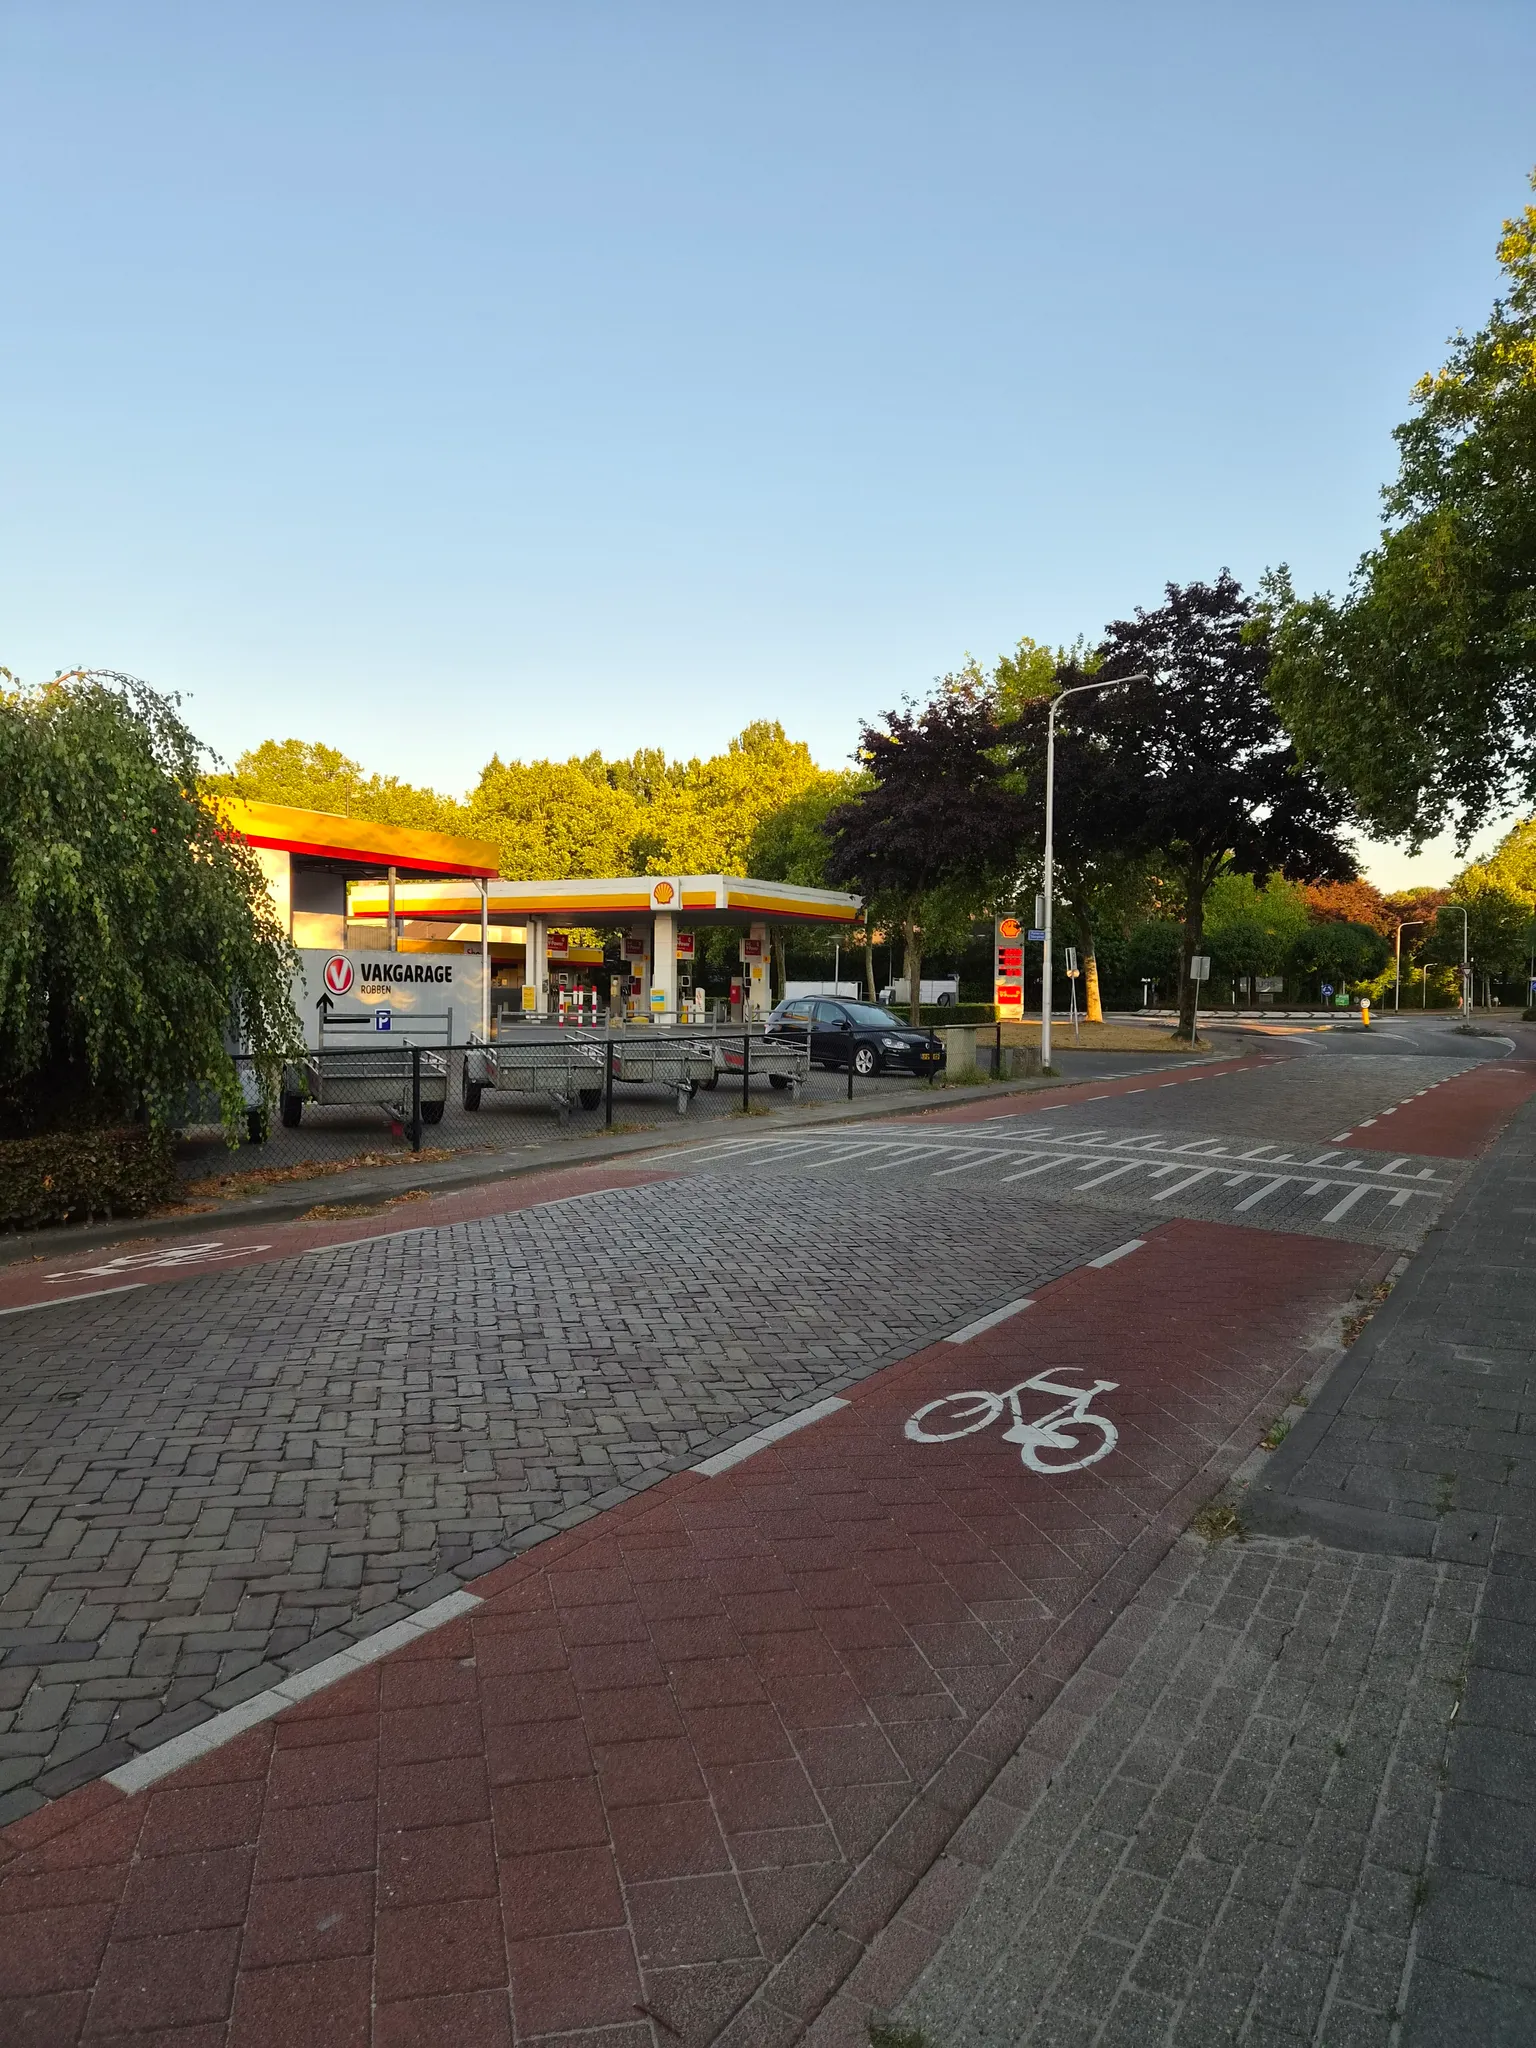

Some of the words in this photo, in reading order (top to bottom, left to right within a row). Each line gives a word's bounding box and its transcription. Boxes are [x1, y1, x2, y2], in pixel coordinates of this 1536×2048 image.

[329, 958, 350, 989] V
[360, 963, 453, 983] VAKGARAGE
[360, 985, 392, 995] ROBBEN
